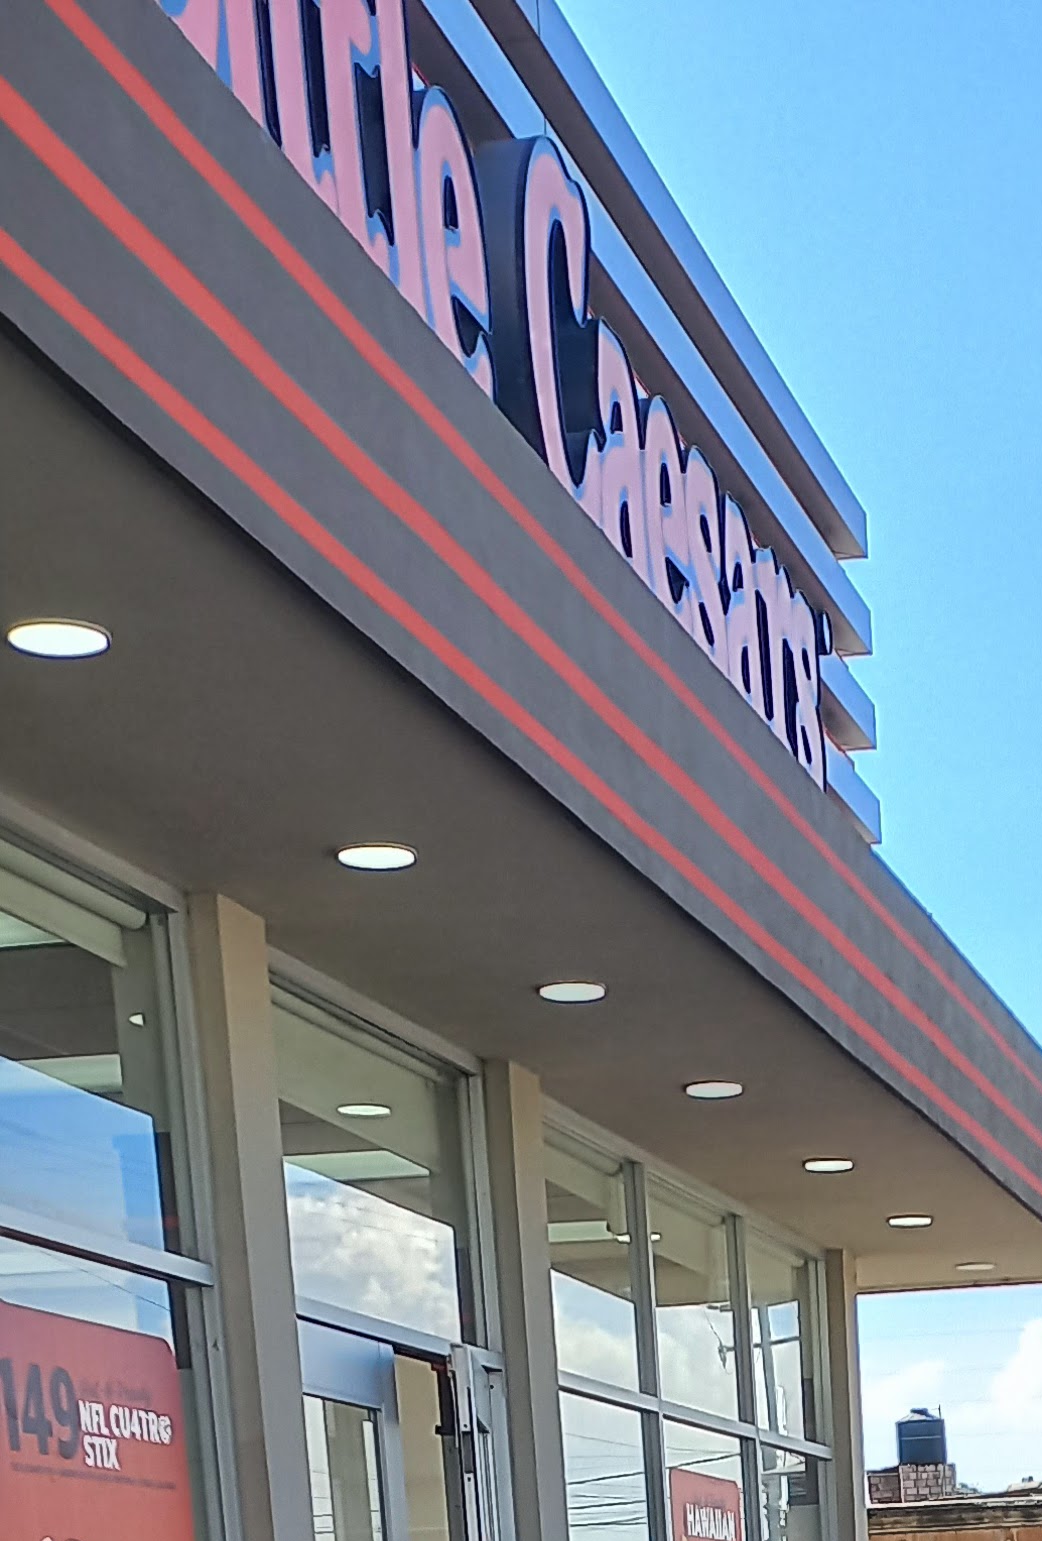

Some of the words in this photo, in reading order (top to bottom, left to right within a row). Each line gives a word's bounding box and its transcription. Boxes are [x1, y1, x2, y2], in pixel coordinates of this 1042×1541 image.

[0, 1356, 81, 1460] 149
[78, 1399, 110, 1434] NFL
[82, 1434, 121, 1472] STIX
